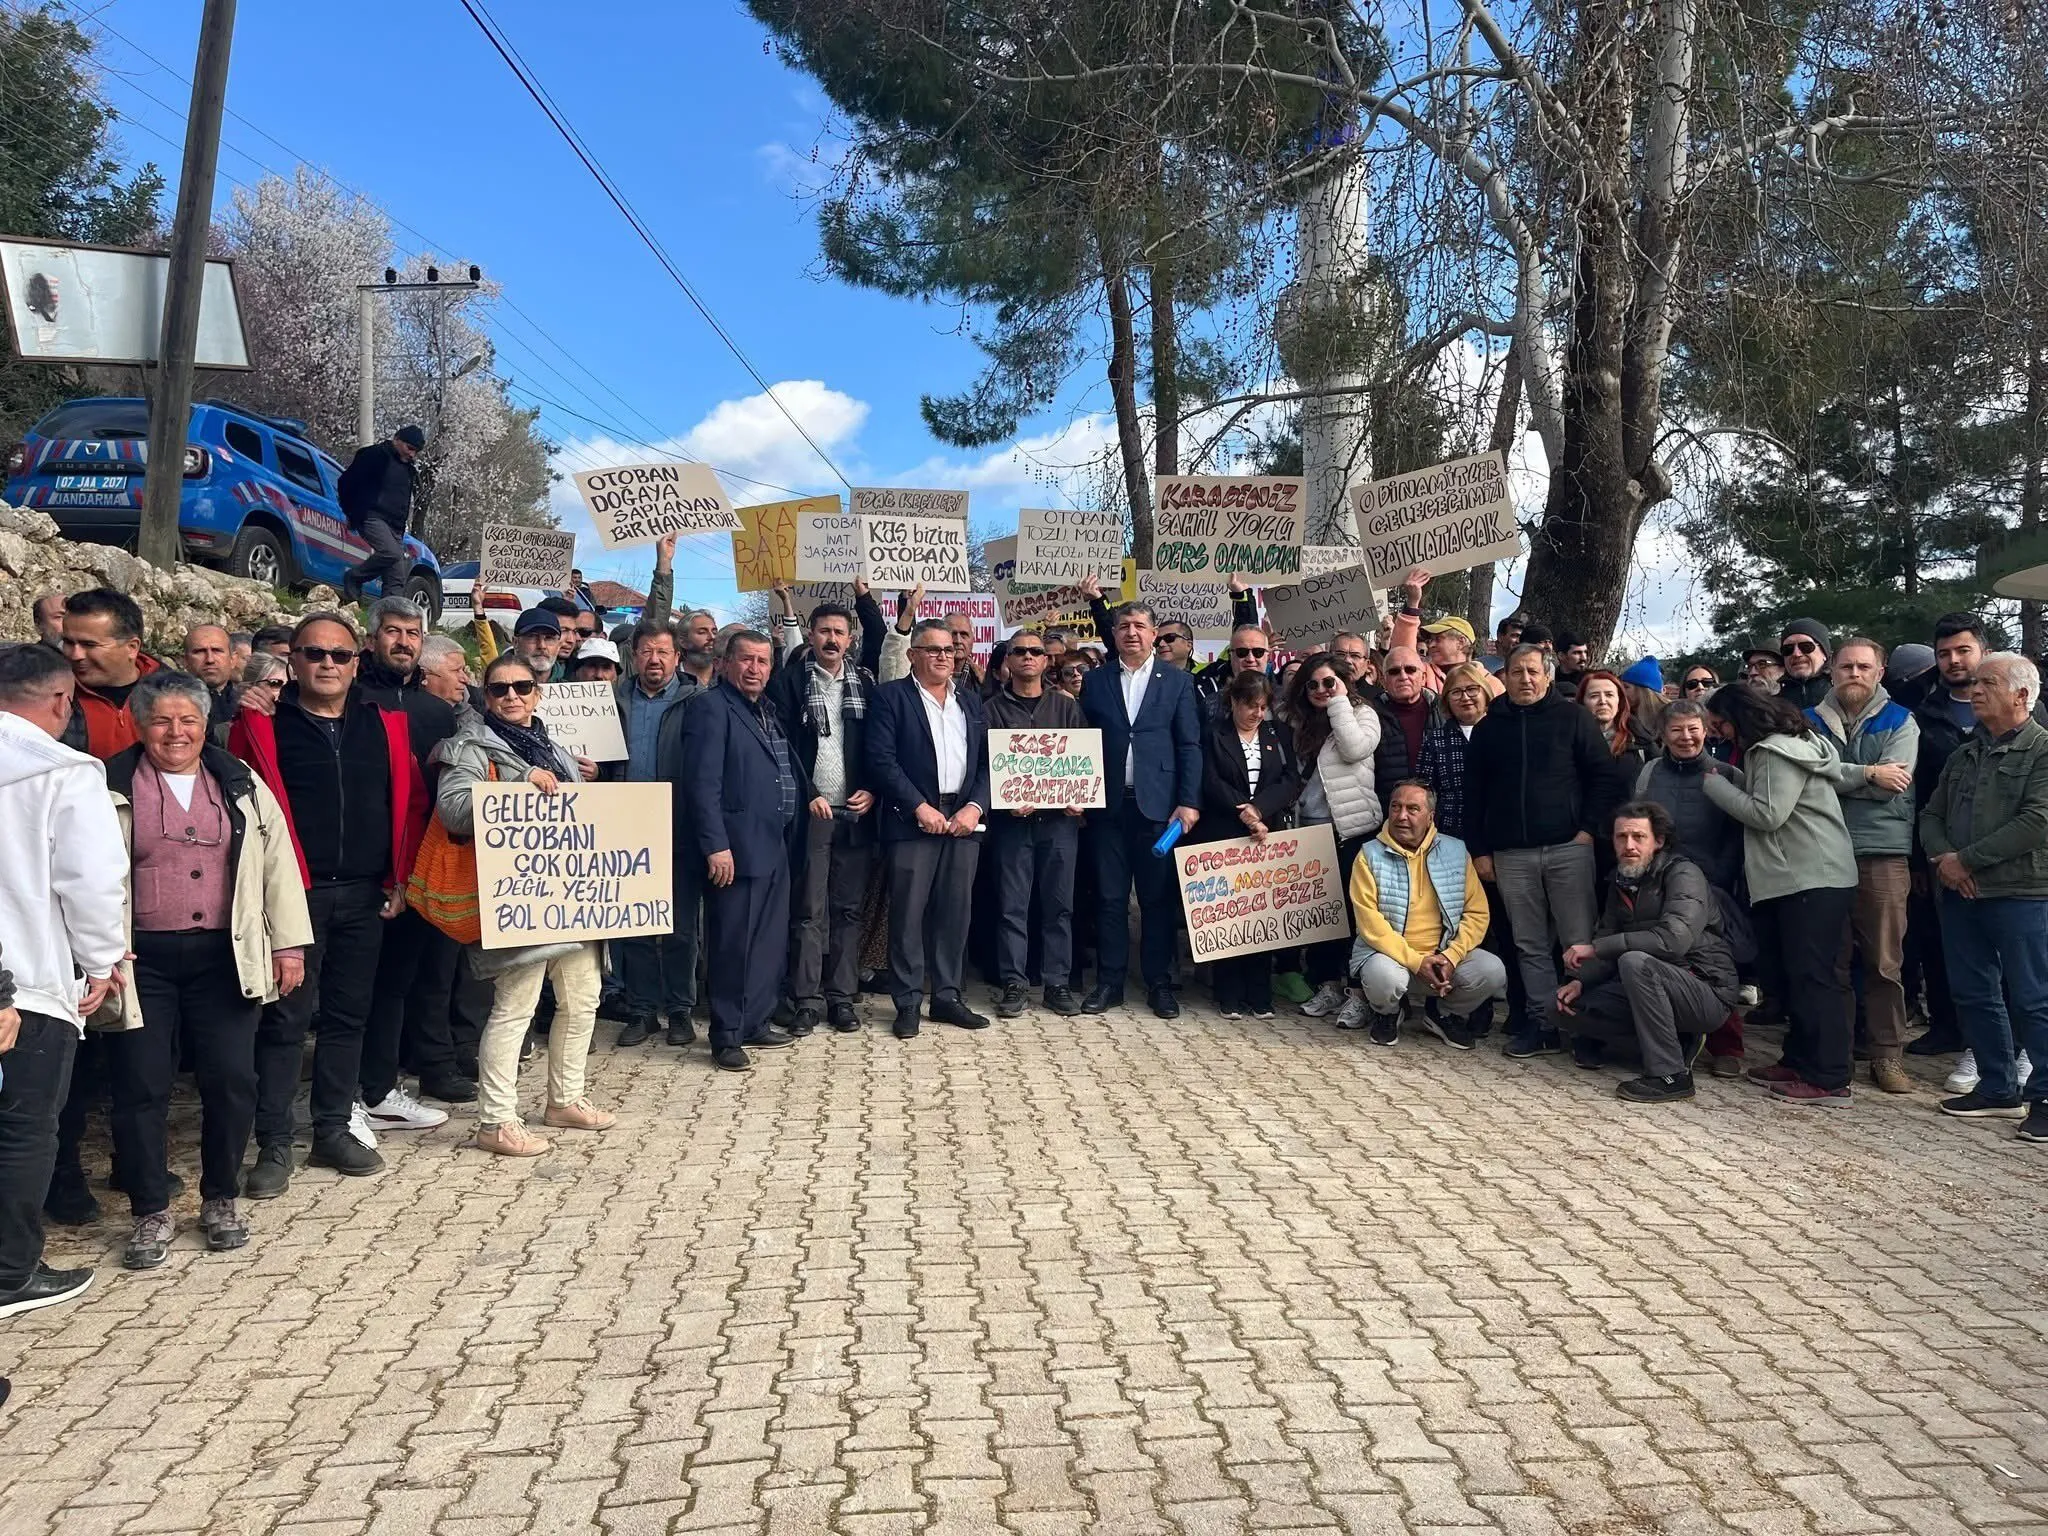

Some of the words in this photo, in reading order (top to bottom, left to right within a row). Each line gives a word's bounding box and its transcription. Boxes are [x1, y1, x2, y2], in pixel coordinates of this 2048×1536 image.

[61, 477, 75, 488] 07
[77, 477, 96, 488] JAA
[102, 477, 123, 488] 207
[588, 467, 679, 491] OTOBAN
[1360, 491, 1374, 513] O
[1378, 460, 1500, 508] DİNAMİTLER
[56, 493, 121, 506] JANDARMA
[591, 483, 679, 513] DOĞAYA
[614, 496, 720, 523] SAPLANAN
[1161, 483, 1299, 513] KARADENİZ
[303, 507, 343, 538] JANDARMA
[609, 521, 647, 543] BİR
[755, 504, 815, 536] KA
[1158, 509, 1219, 537] SAHİL
[1224, 511, 1295, 541] YOLU
[488, 545, 564, 564] SATMA!
[734, 534, 797, 563] BAB
[869, 546, 959, 564] OTOBAN
[1156, 541, 1209, 573] DERS
[484, 569, 567, 588] YAKMA!
[824, 561, 864, 573] HAYAT
[921, 566, 966, 584] OLSUN
[1275, 567, 1368, 602] OTOBANA
[449, 597, 469, 605] 0002
[1338, 606, 1375, 626] HAYAT
[482, 792, 579, 824] GELECEK
[485, 823, 595, 850] OTOBANI
[514, 853, 560, 877] ÇOK
[565, 847, 651, 878] OLANDA
[562, 878, 620, 904] YEŞİLİ
[495, 903, 537, 932] BOL
[1195, 917, 1279, 955] PARALAR
